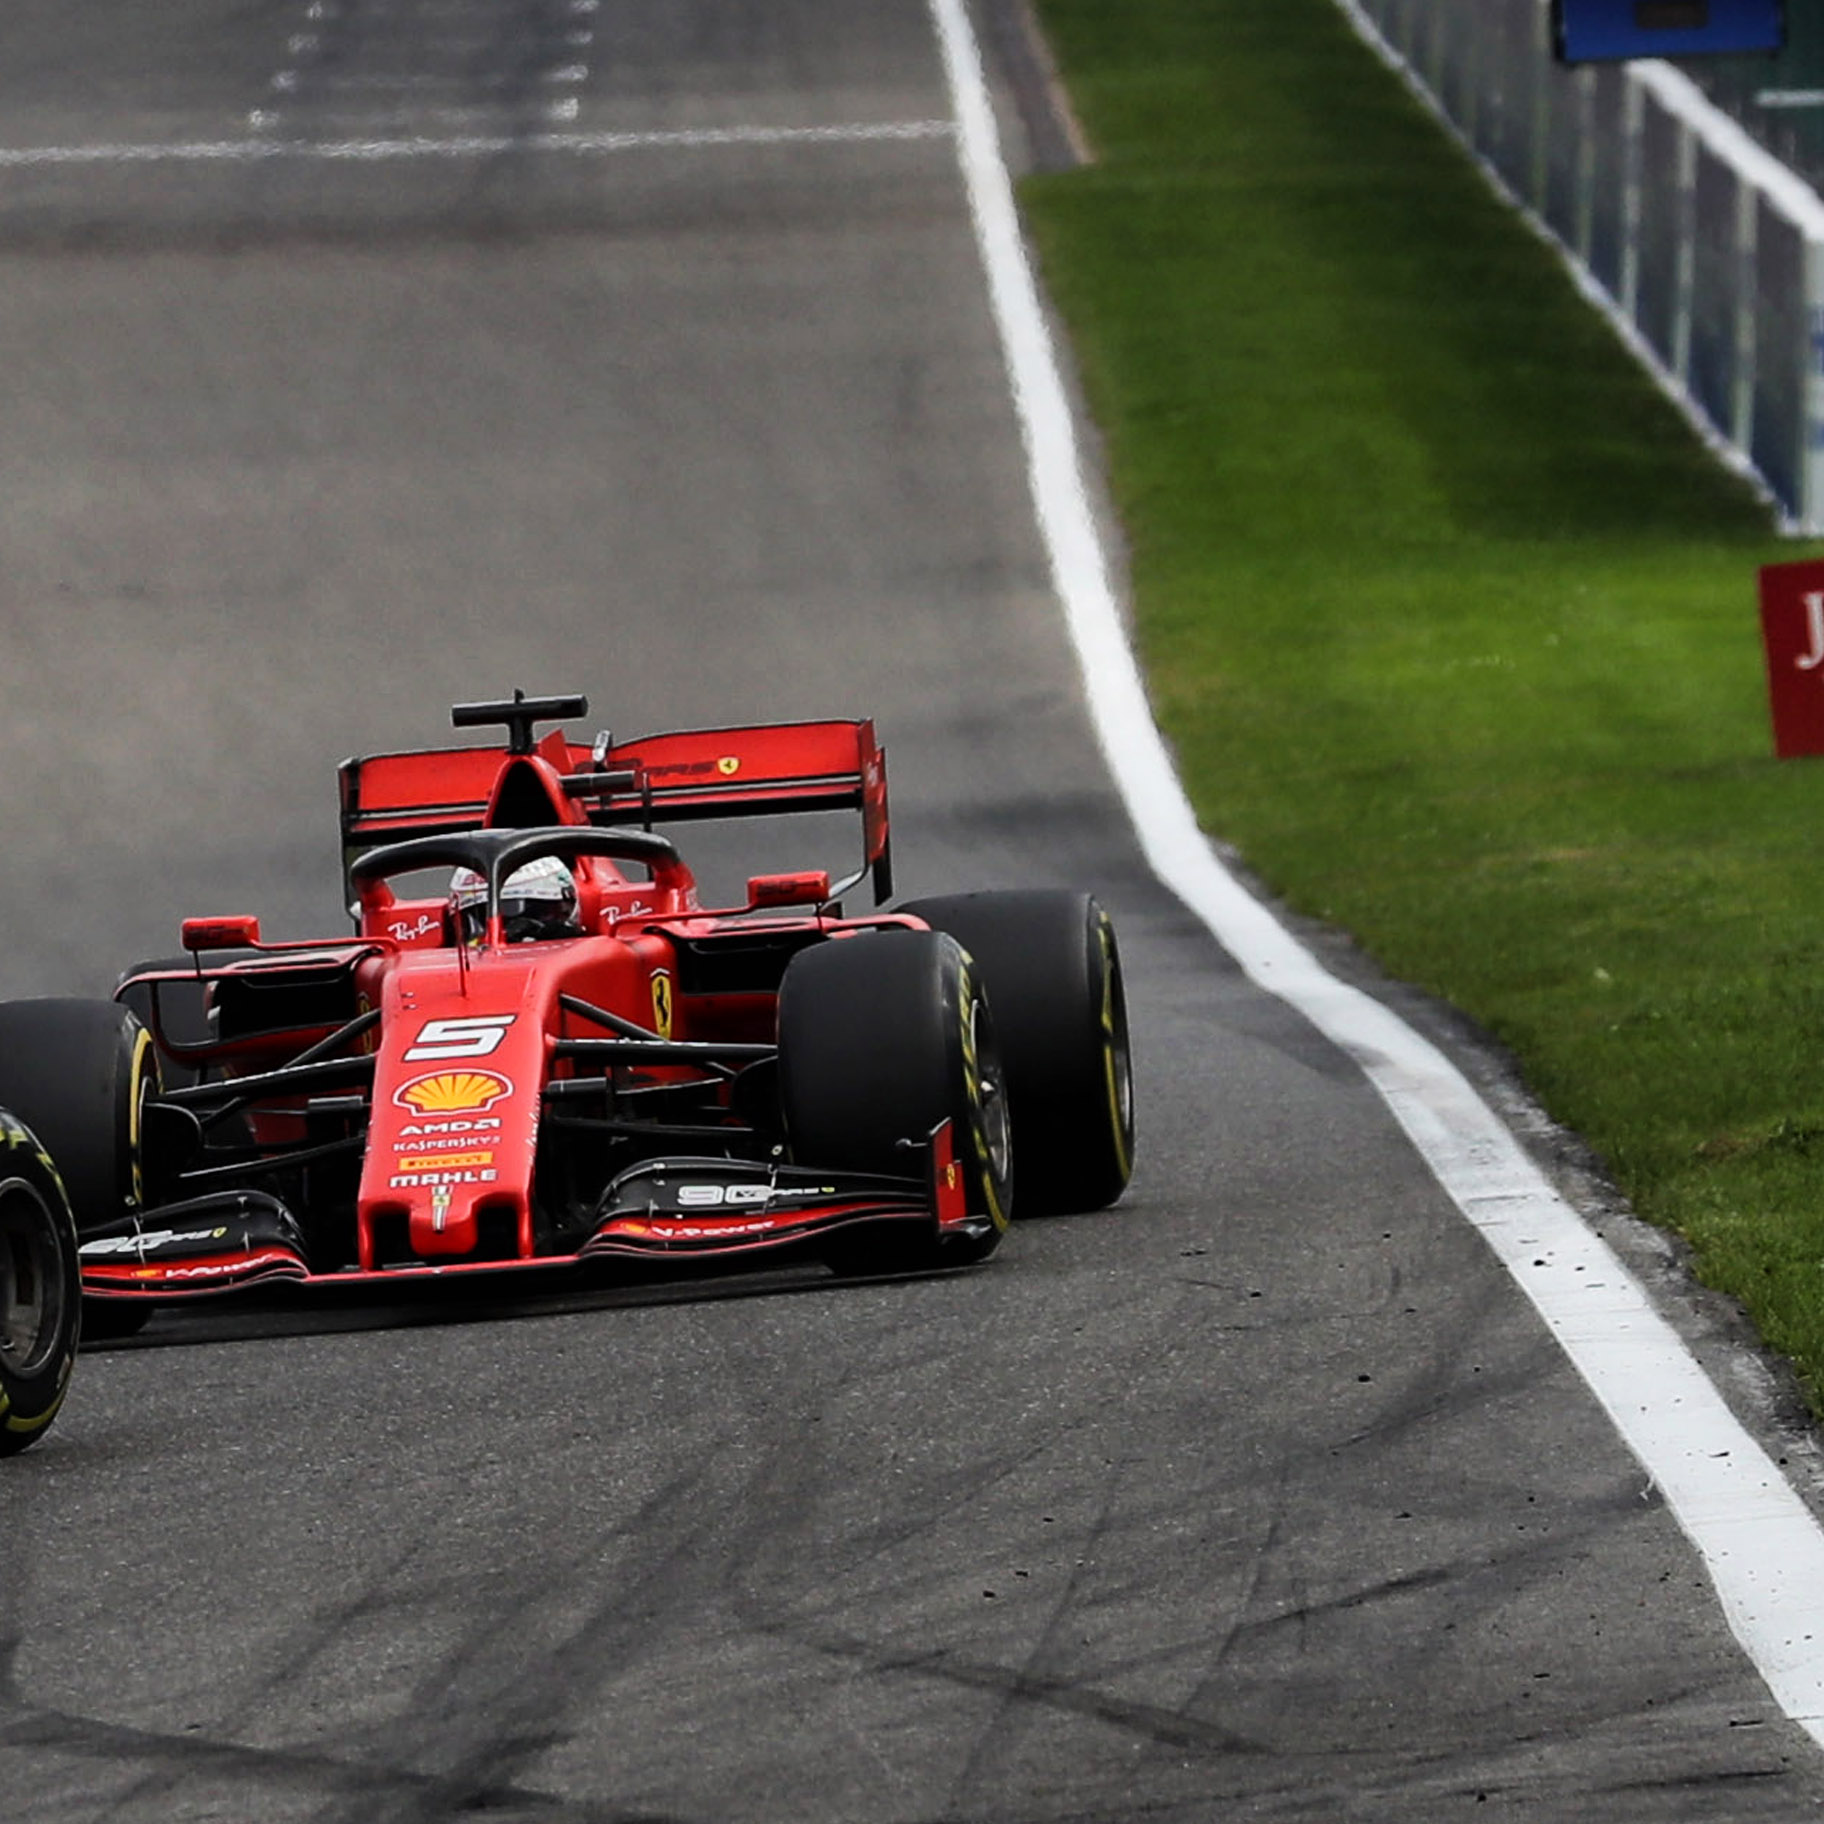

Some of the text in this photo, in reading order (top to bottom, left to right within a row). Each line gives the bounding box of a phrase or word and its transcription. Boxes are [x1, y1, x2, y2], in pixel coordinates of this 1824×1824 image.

[404, 1014, 517, 1062] 5
[398, 1121, 475, 1137] AMD
[389, 1169, 498, 1188] MAHLE
